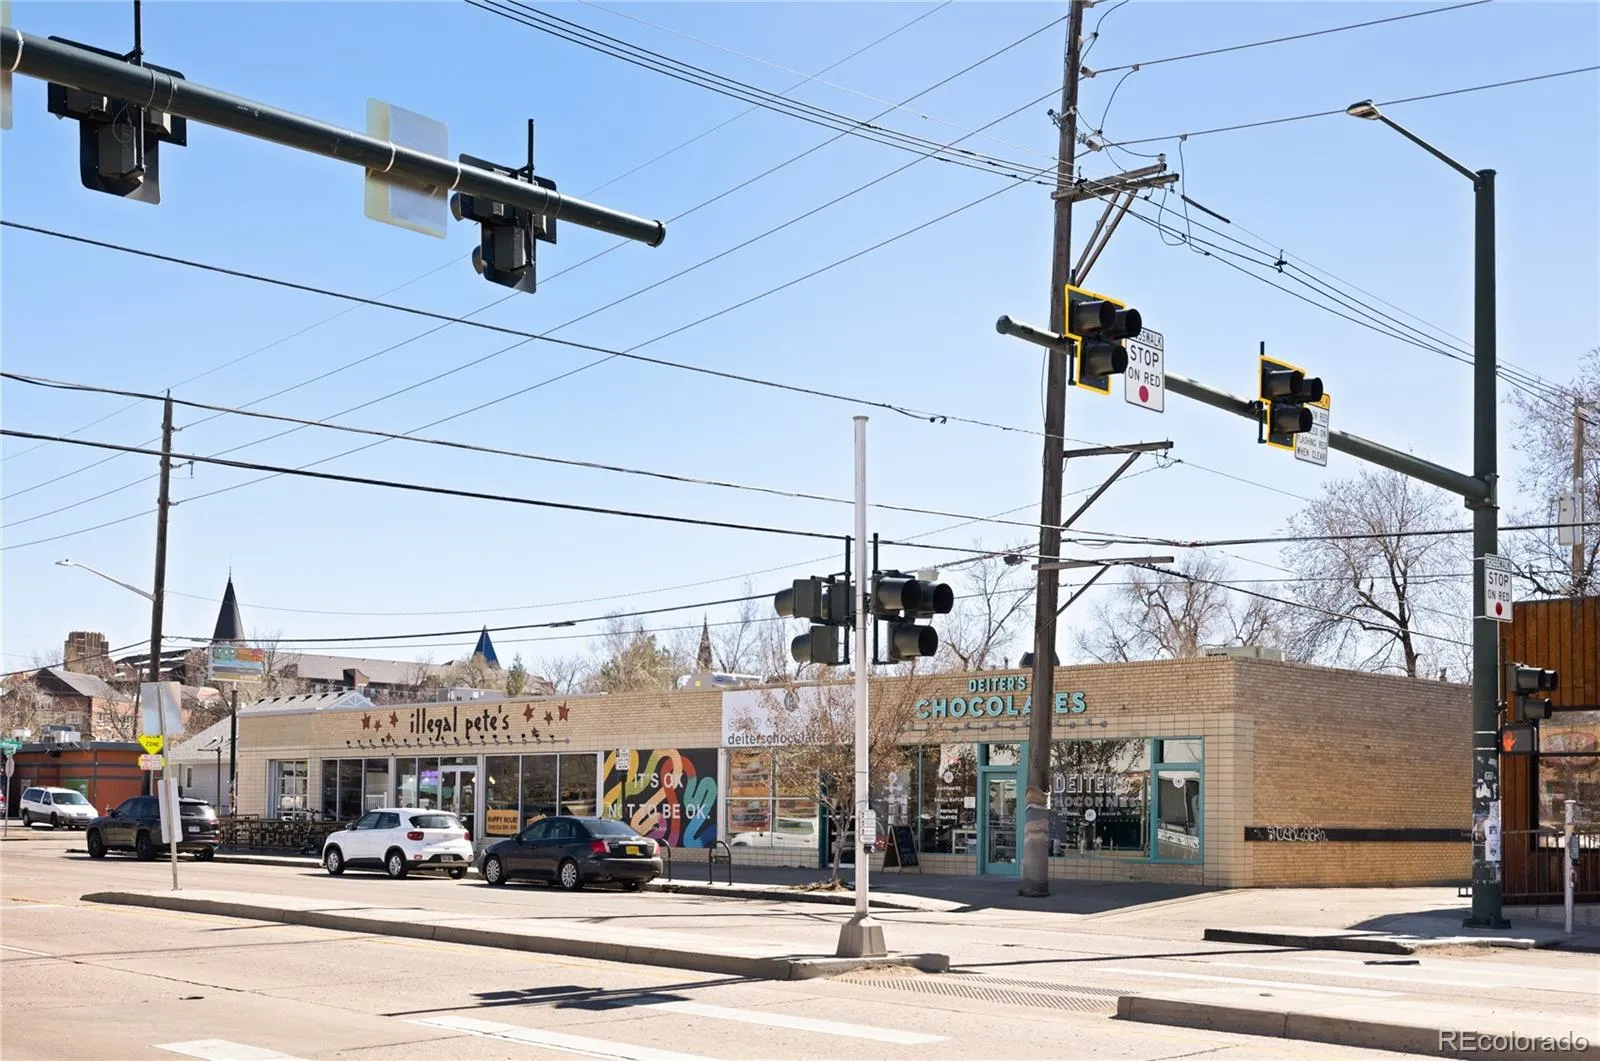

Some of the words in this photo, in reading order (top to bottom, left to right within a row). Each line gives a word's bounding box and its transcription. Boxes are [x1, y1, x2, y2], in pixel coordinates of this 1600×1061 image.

[1130, 345, 1160, 368] STOP
[1128, 366, 1140, 381] ON
[1144, 371, 1161, 388] RED
[1297, 447, 1309, 456] WHEN
[1311, 450, 1326, 461] CLEAR
[1489, 571, 1509, 586] STOP
[1488, 589, 1496, 600] ON
[1498, 591, 1510, 602] RED
[968, 676, 1027, 692] DEITER'S
[916, 691, 1087, 720] CHOCOLAES
[410, 705, 458, 742] illegal
[465, 704, 509, 740] pete's
[633, 772, 659, 789] IT'S
[664, 772, 684, 789] OK
[662, 803, 681, 819] BE
[685, 803, 711, 819] OK.
